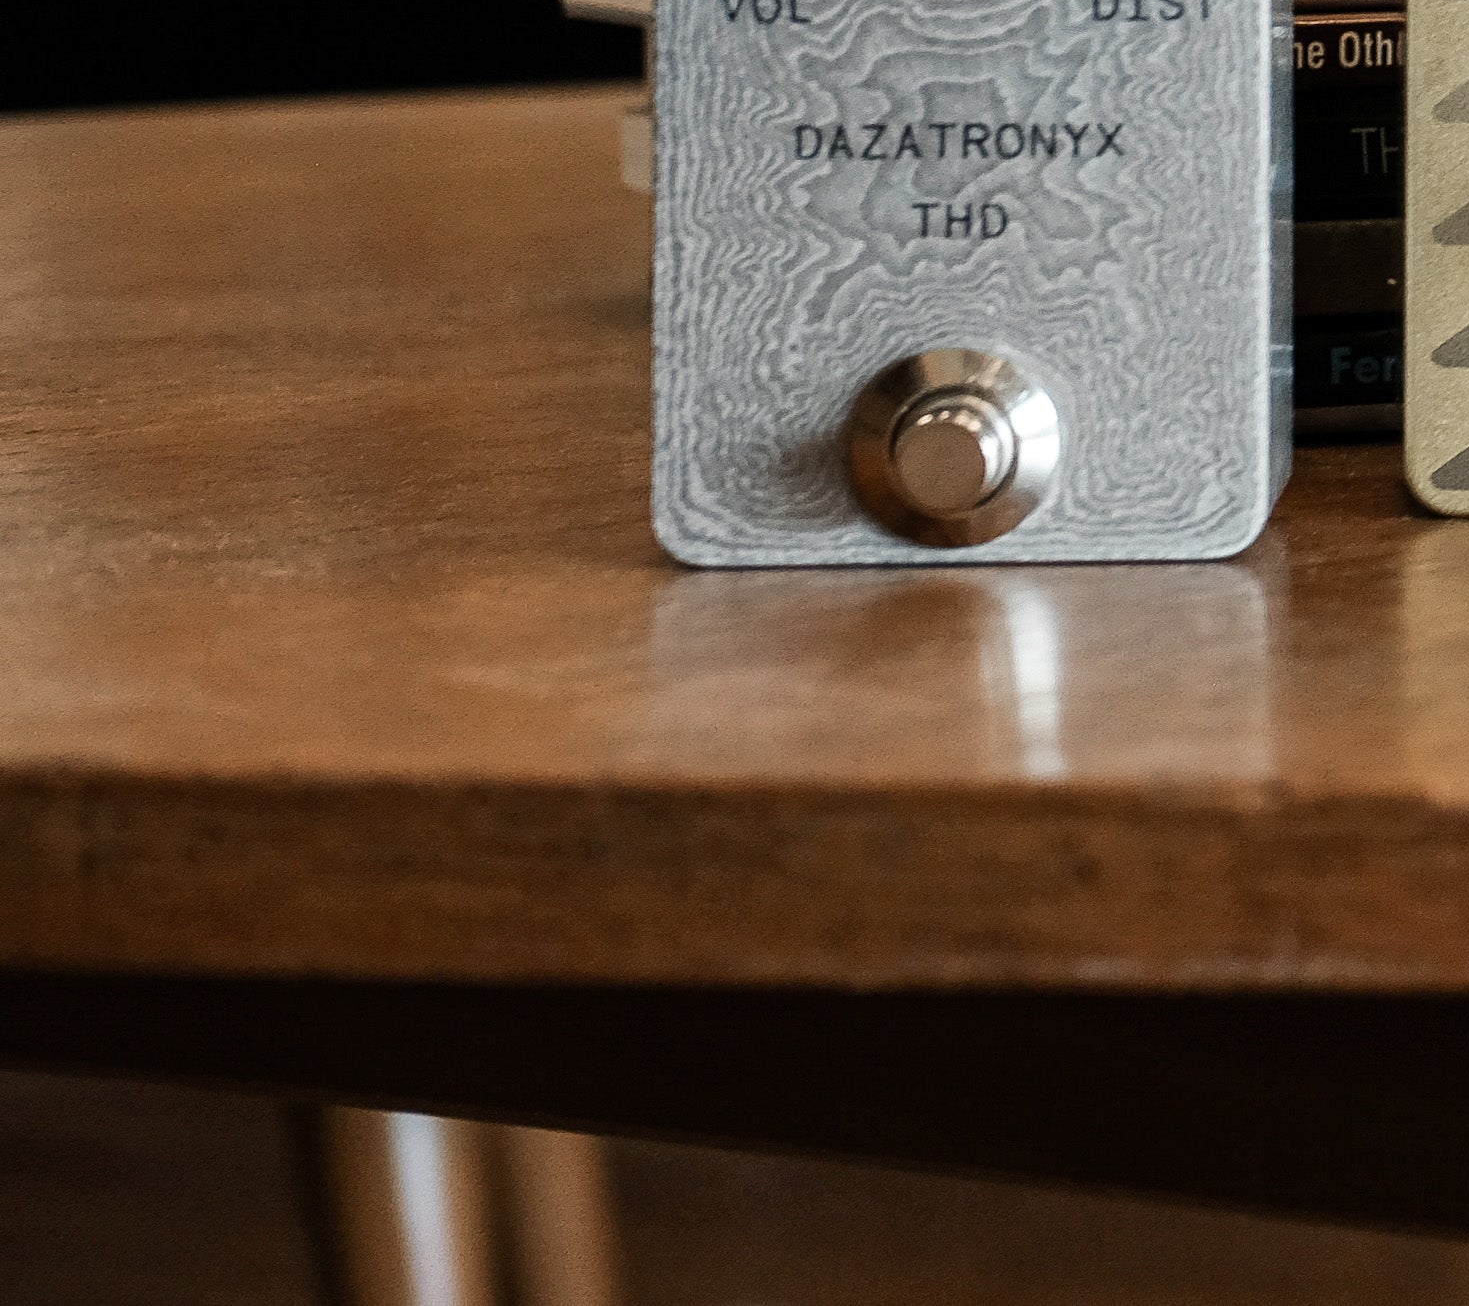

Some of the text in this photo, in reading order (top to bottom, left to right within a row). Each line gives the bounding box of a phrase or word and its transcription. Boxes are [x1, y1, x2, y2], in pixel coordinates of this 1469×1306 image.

[1339, 30, 1406, 68] Oth
[792, 124, 1126, 161] DAZATRONYX
[912, 203, 1009, 240] THD
